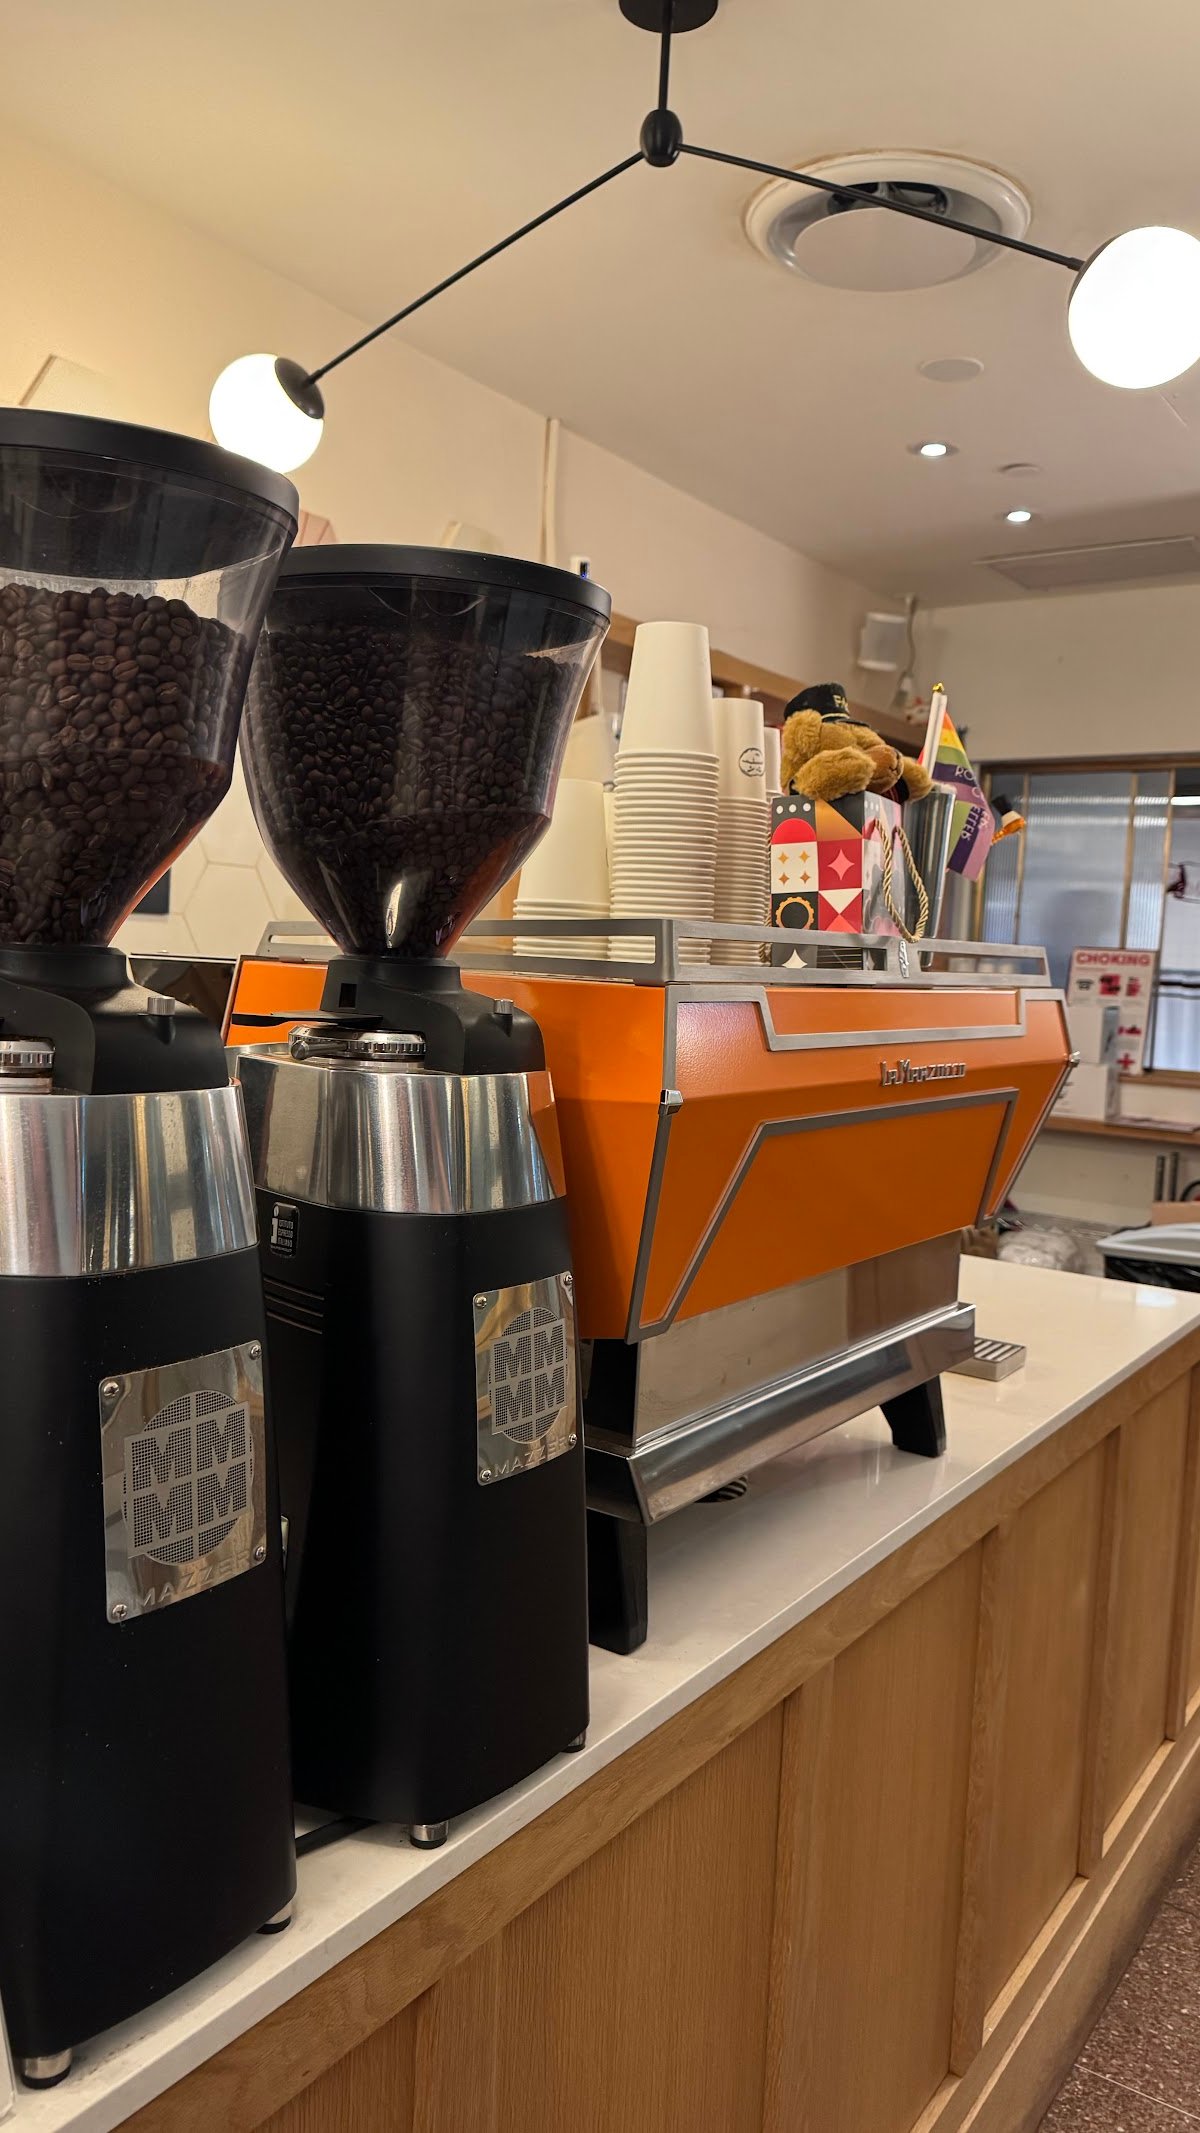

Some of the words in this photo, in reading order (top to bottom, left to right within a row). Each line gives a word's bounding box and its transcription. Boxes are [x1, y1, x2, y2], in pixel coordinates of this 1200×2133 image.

[1076, 952, 1150, 966] CHOKING
[494, 1437, 567, 1478] MAZZER
[132, 1552, 251, 1612] MAZZER
